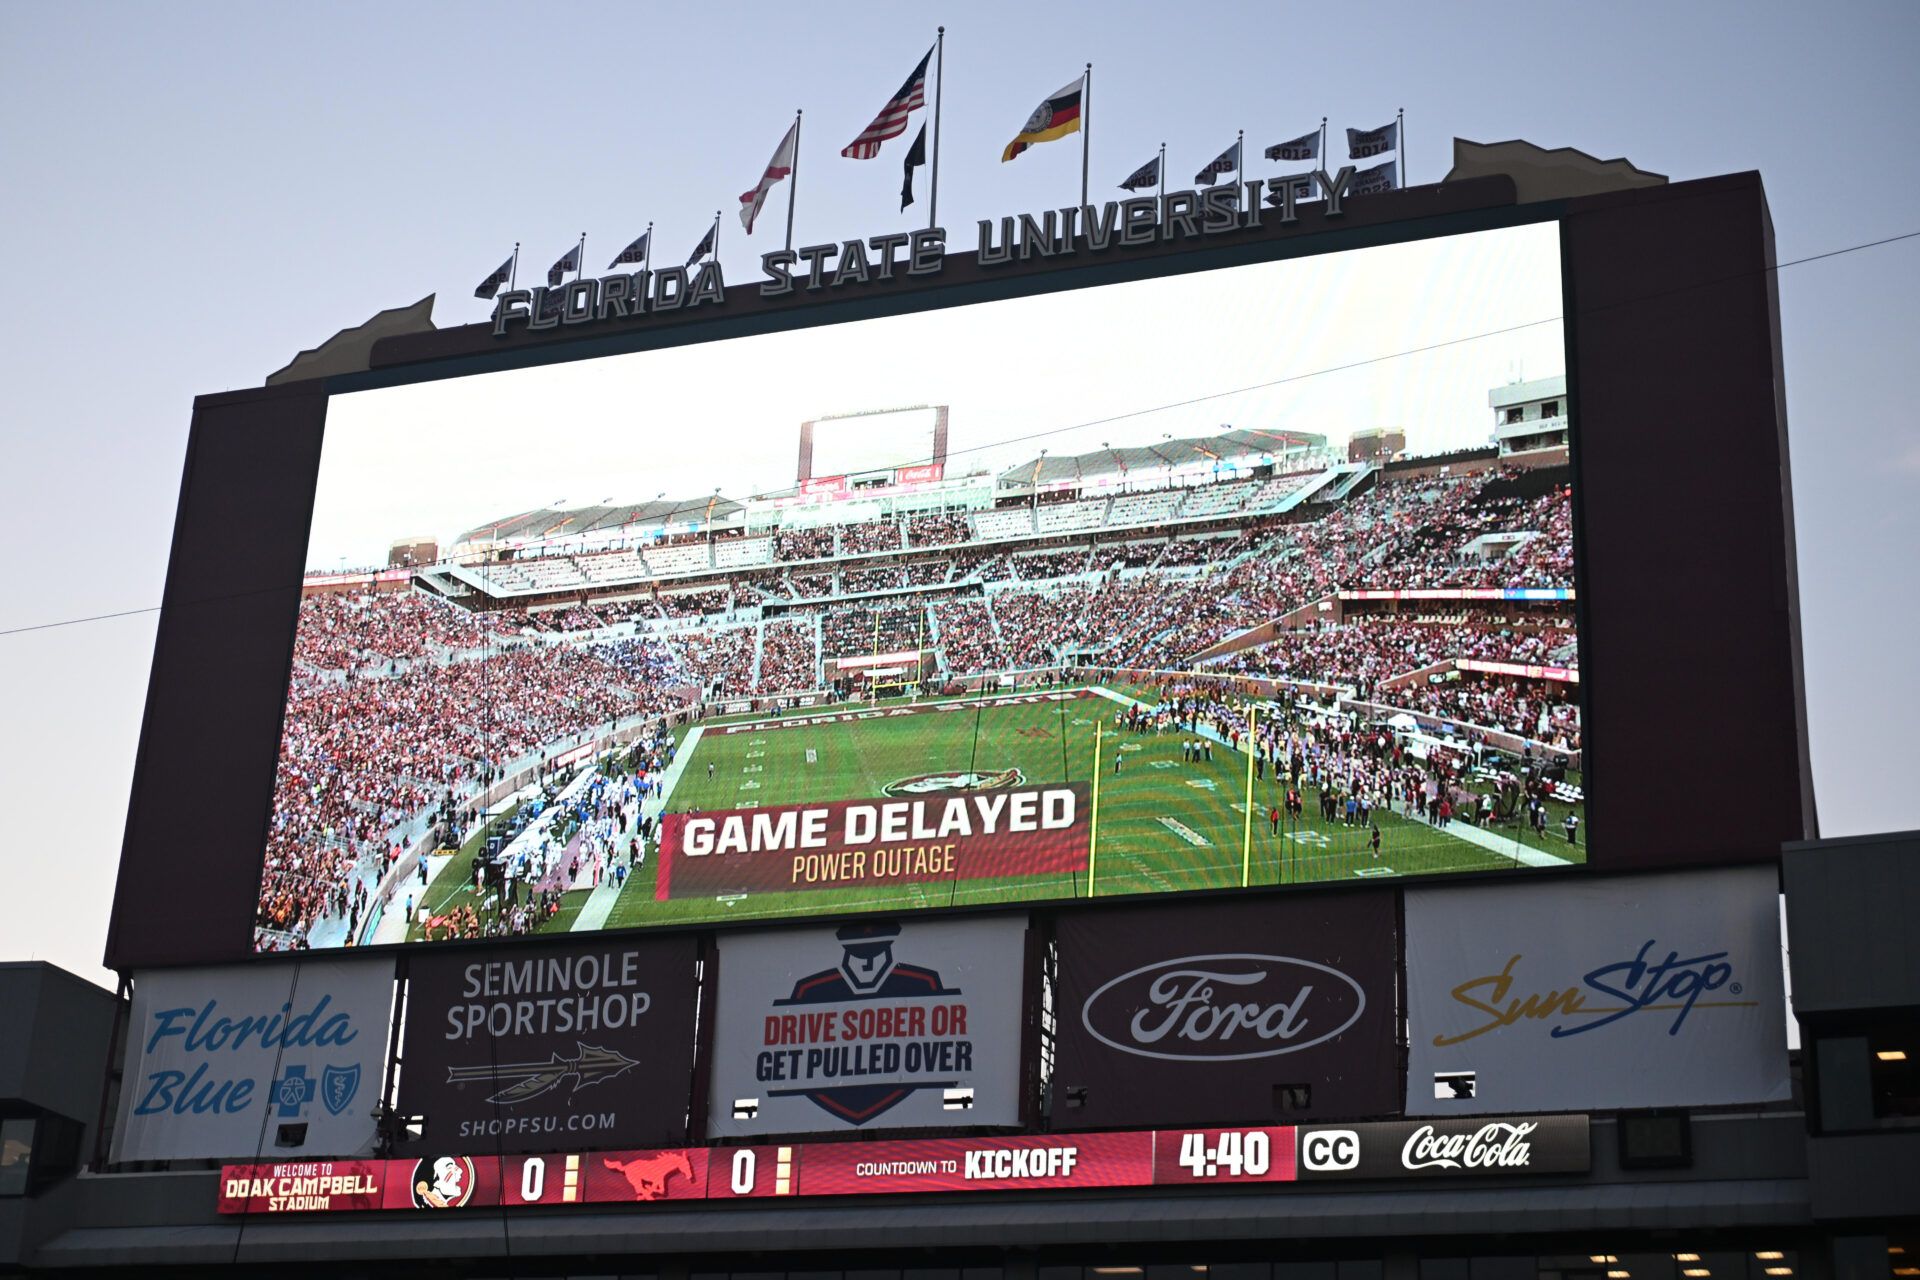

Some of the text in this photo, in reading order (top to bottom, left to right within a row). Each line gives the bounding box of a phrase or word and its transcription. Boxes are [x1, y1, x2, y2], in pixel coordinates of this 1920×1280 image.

[1271, 149, 1312, 160] 2012
[1351, 142, 1389, 157] 2014
[491, 261, 725, 336] FLORIDA
[759, 227, 946, 297] STATE
[978, 165, 1357, 266] UNIVERSITY
[682, 789, 1077, 857] GAME DELAYED
[792, 844, 956, 883] POWER OUTAGE
[463, 951, 640, 999] SEMINOLE
[146, 994, 359, 1054] Florida
[445, 992, 651, 1040] SPORTSHOP
[763, 1004, 967, 1046] DRIVE SOBER OR
[1131, 970, 1314, 1044] Ford
[756, 1041, 973, 1082] GET PULLED OVER
[134, 1062, 256, 1117] Blue
[459, 1113, 616, 1137] SHOPFSU.COM
[1401, 1121, 1538, 1170] Coca-Cola
[273, 1162, 334, 1178] WELCOME TO
[856, 1147, 1078, 1181] COUNTDOWN TO KICKOFF
[1178, 1131, 1270, 1178] 4:40
[1308, 1136, 1355, 1164] CC
[225, 1174, 378, 1199] DOAK CAMPBELL
[520, 1157, 545, 1202] 0
[730, 1149, 756, 1196] 0
[269, 1195, 330, 1212] STADIUM
